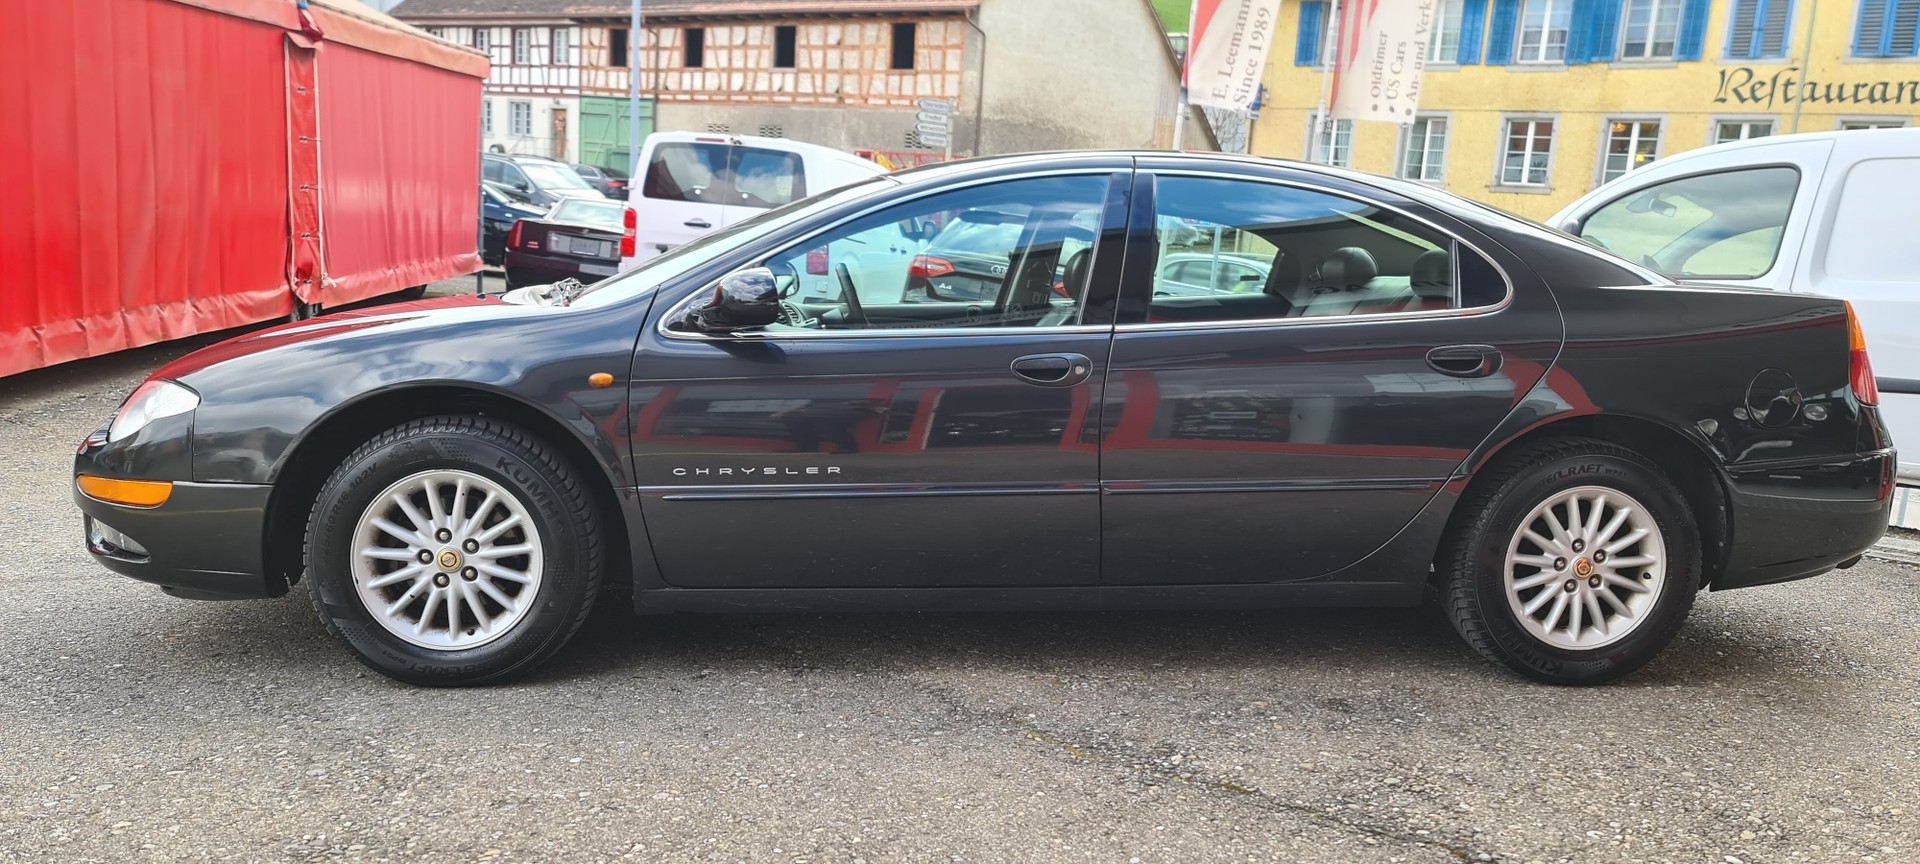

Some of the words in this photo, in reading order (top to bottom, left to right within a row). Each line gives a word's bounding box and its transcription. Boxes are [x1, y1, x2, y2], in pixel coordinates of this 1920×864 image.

[1217, 0, 1252, 79] Leemann
[1233, 58, 1258, 104] Since
[1248, 7, 1271, 52] 1989
[1370, 30, 1388, 98] Oldtimer
[1390, 41, 1407, 75] Cars
[1414, 41, 1425, 70] und
[1211, 84, 1229, 100] E.
[1386, 79, 1401, 100] US
[672, 466, 841, 476] CHRYSLER
